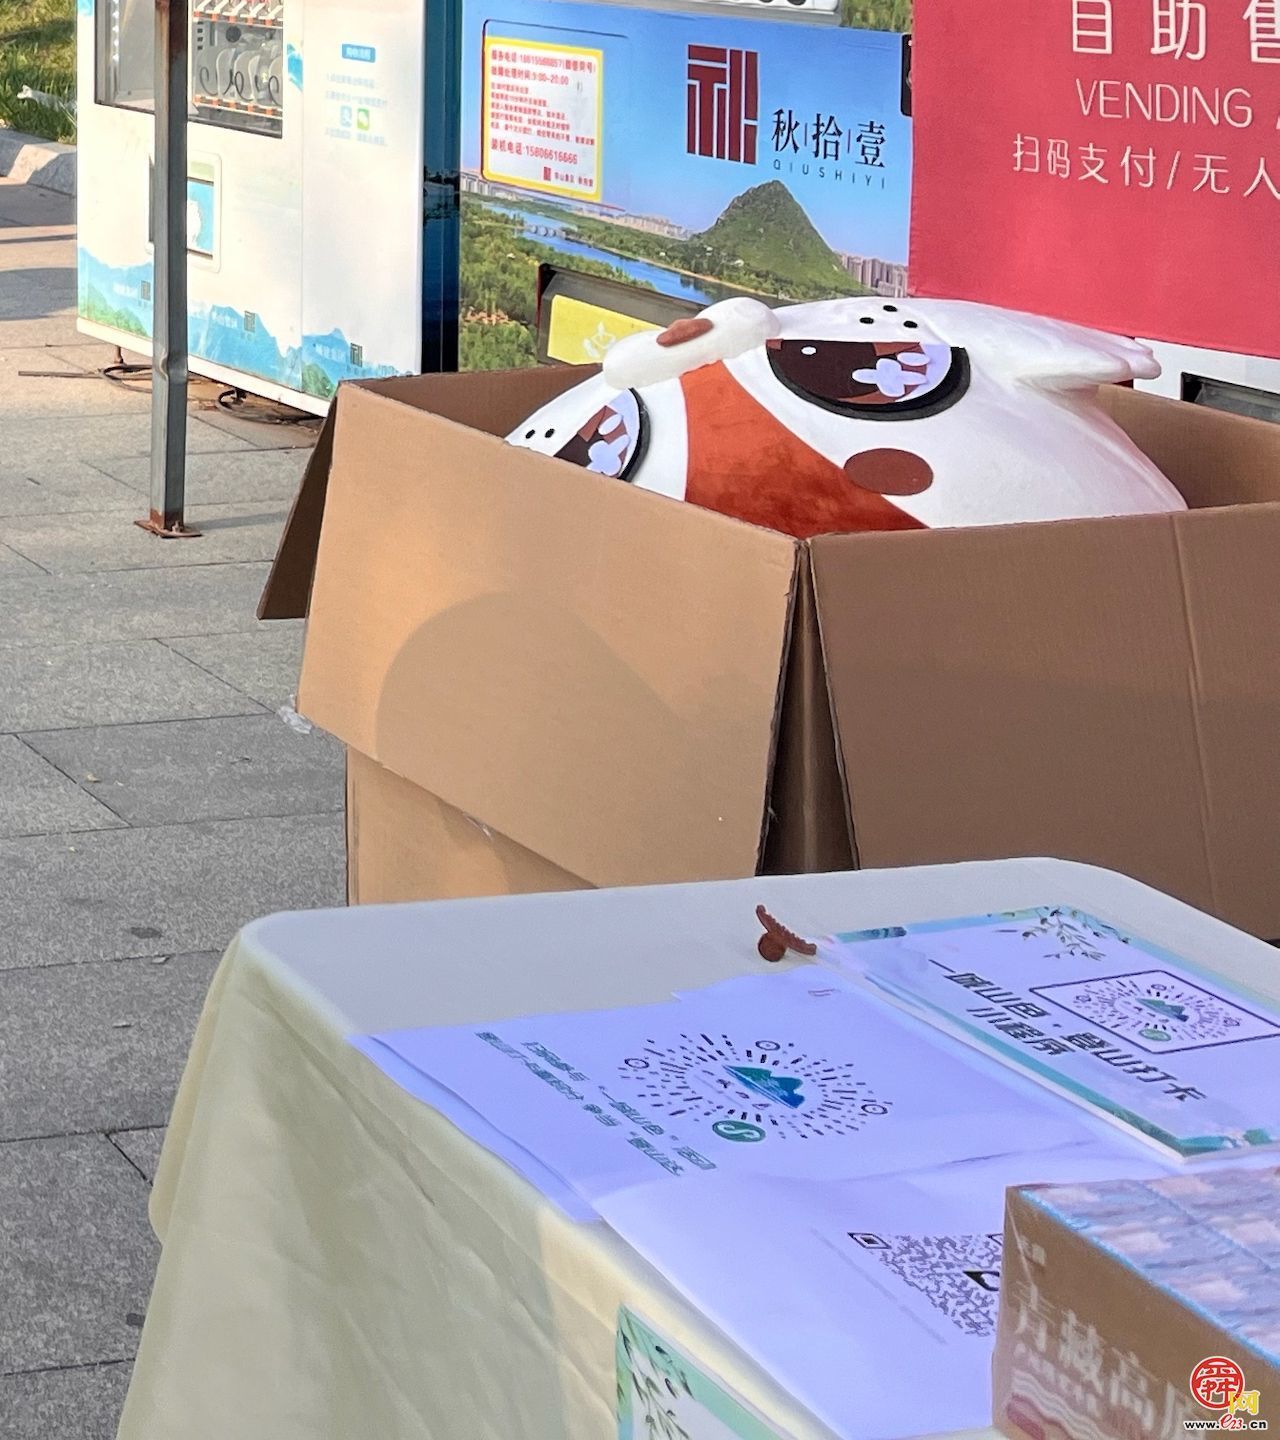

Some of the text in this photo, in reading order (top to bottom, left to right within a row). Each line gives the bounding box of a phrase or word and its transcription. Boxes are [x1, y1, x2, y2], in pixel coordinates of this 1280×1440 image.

[1076, 78, 1253, 128] VENDING
[773, 160, 886, 189] QIUSHIYI
[1013, 133, 1280, 200] 扫码支付/无人
